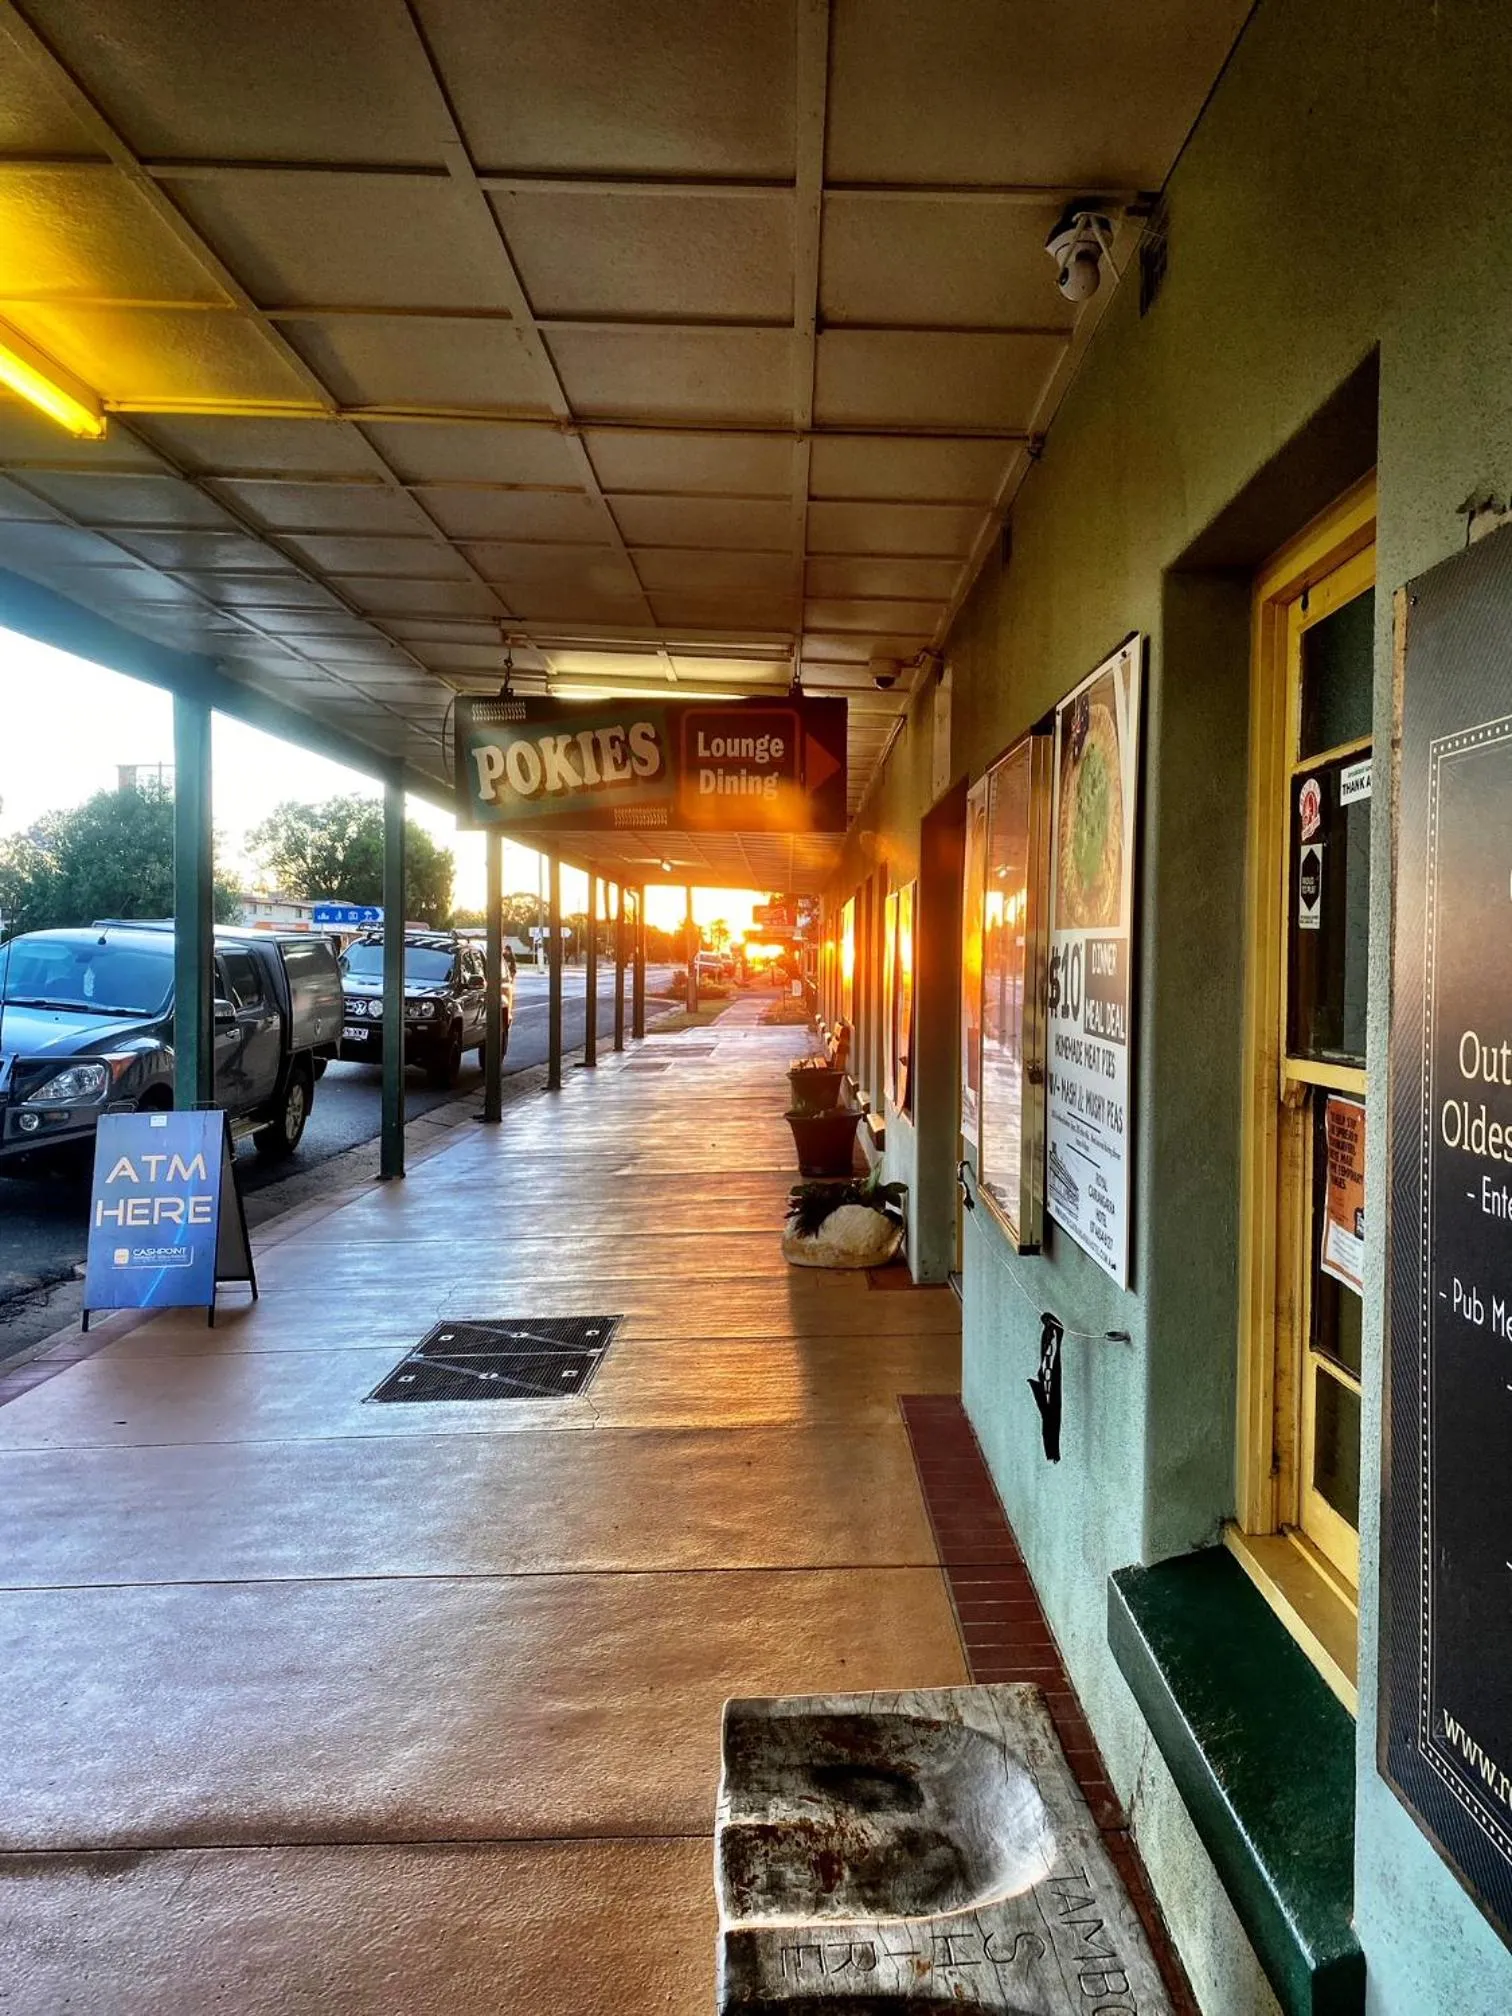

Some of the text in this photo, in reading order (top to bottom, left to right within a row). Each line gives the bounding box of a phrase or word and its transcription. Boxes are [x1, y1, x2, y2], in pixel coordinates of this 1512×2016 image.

[472, 722, 660, 800] POKIES
[697, 731, 785, 764] Lounge
[699, 769, 779, 800] Dining
[1342, 776, 1365, 796] THANK
[1048, 943, 1081, 1021] $10
[1091, 942, 1118, 977] DINNER
[1085, 998, 1126, 1039] MEAL DEAL
[1054, 1032, 1116, 1080] HOMEMADE MEAT PIES
[1460, 1030, 1512, 1085] Out
[1061, 1076, 1077, 1108] MASH
[1077, 1084, 1085, 1114] &
[1085, 1087, 1106, 1124] MUSHY
[1106, 1098, 1123, 1135] PEAS
[1442, 1099, 1512, 1164] Oldes
[104, 1152, 207, 1184] ATM
[95, 1195, 213, 1228] HERE
[133, 1247, 187, 1257] CASHPOINT
[1453, 1277, 1485, 1325] Pub
[1443, 1708, 1512, 1811] www.r
[780, 1930, 1048, 1978] SHIRE
